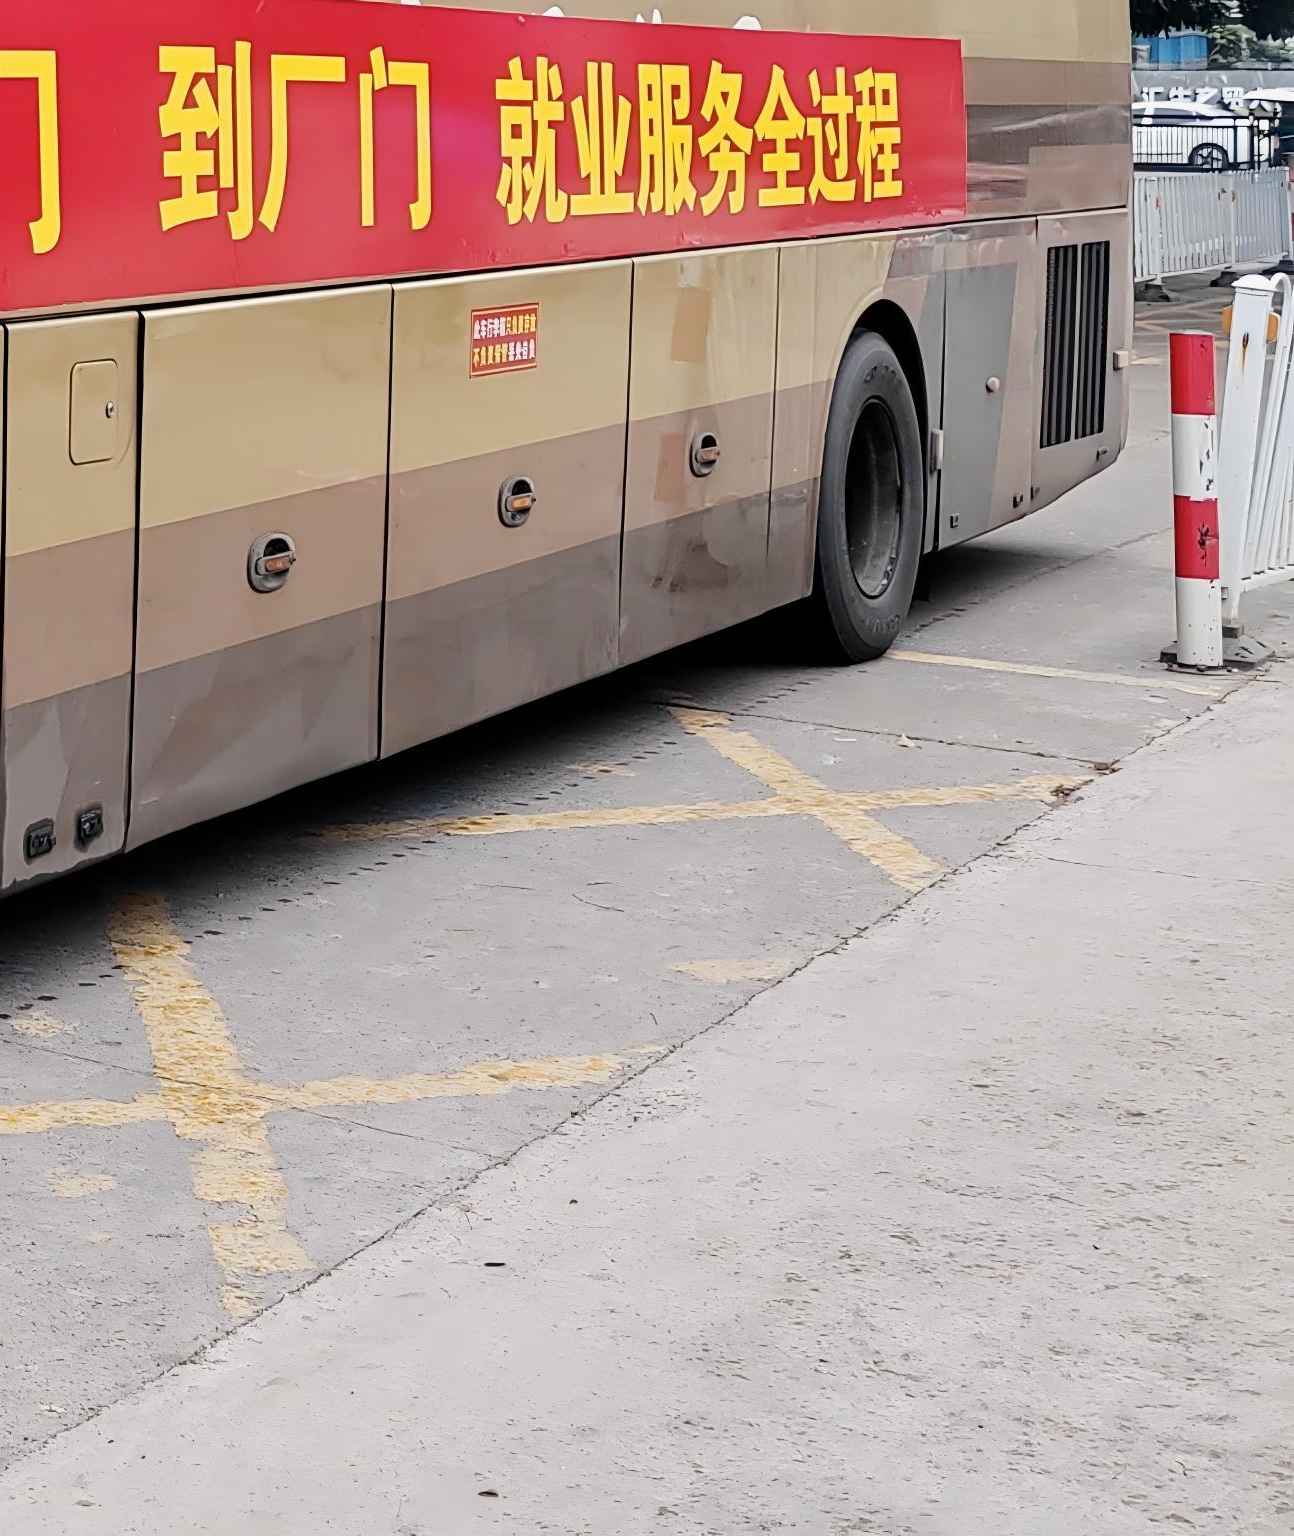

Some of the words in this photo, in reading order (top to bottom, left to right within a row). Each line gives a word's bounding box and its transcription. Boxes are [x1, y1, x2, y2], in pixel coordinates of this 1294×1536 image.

[157, 41, 432, 241] 到厂门
[495, 54, 904, 225] 就业服务全过程
